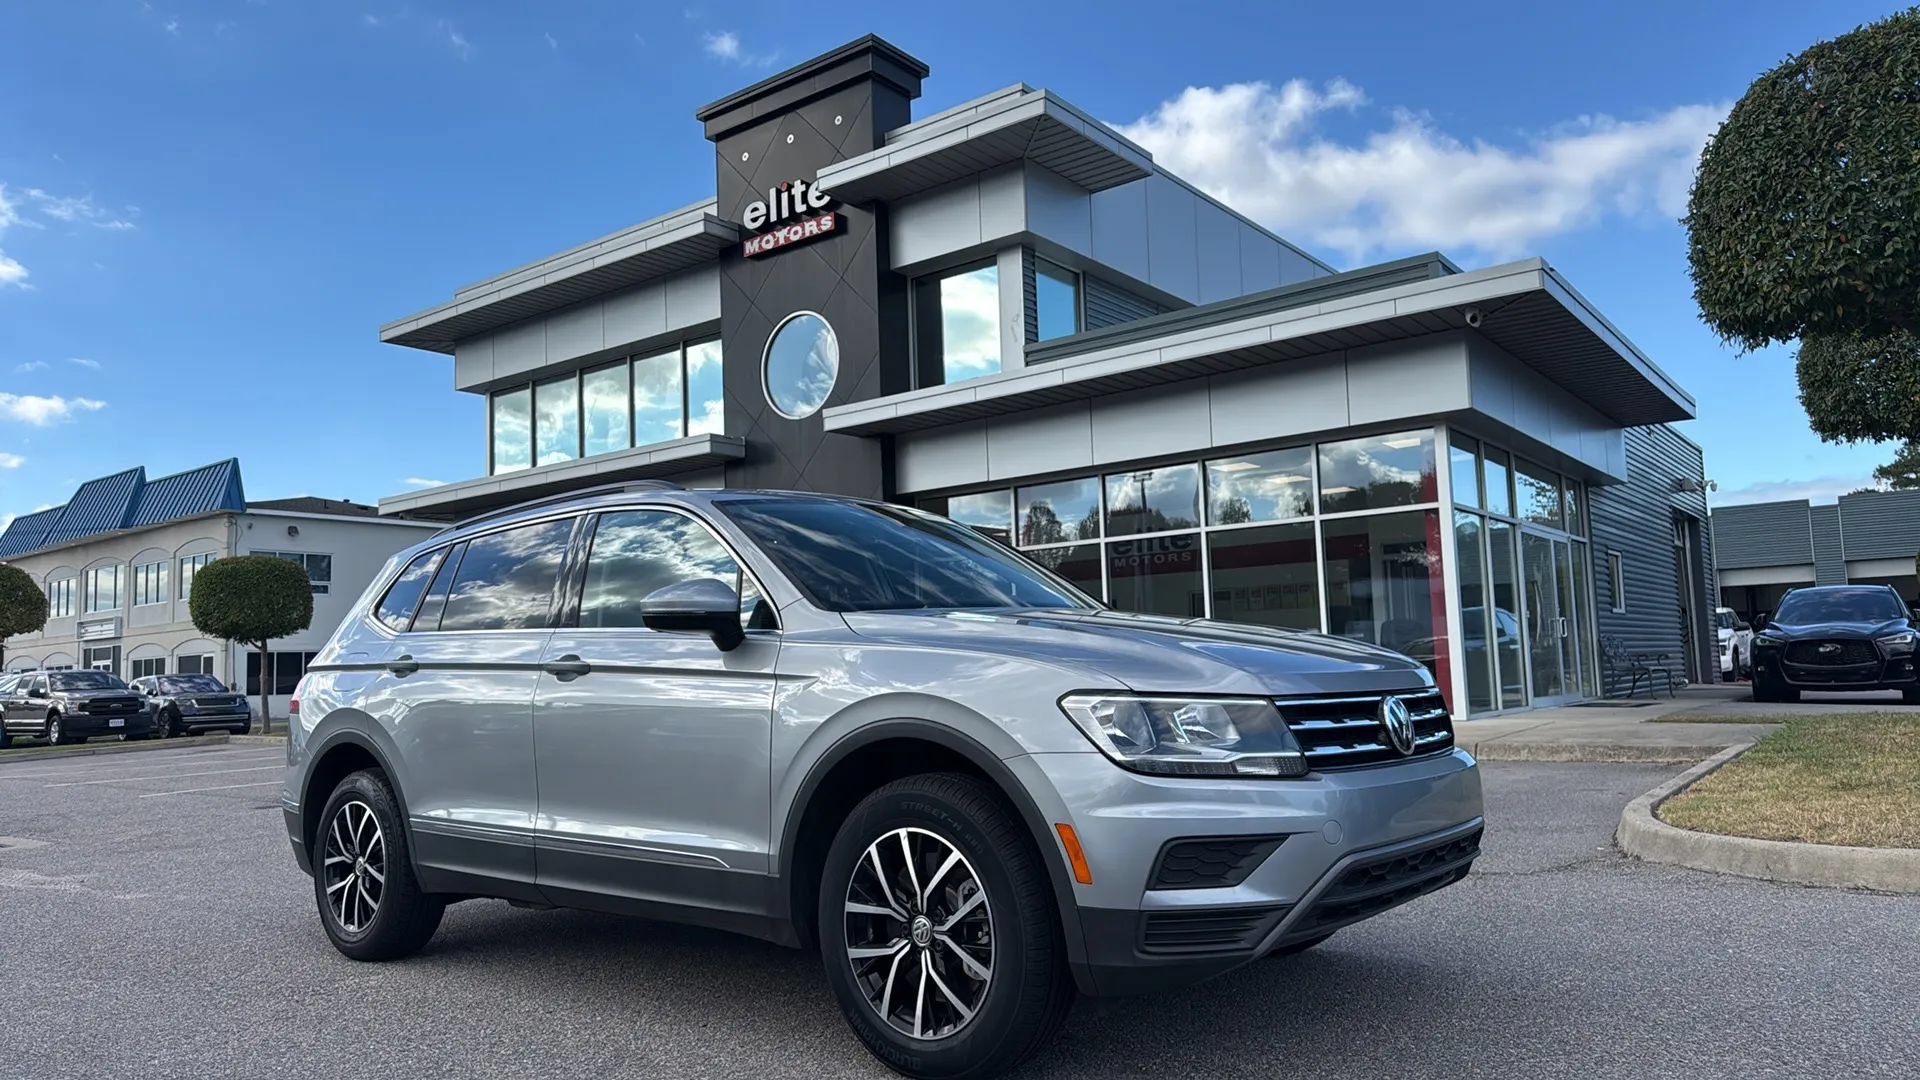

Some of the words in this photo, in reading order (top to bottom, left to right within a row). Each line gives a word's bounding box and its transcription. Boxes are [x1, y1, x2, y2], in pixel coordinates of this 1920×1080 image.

[743, 179, 831, 230] elite
[744, 216, 833, 254] MOTORS
[1114, 551, 1192, 568] MOTORS
